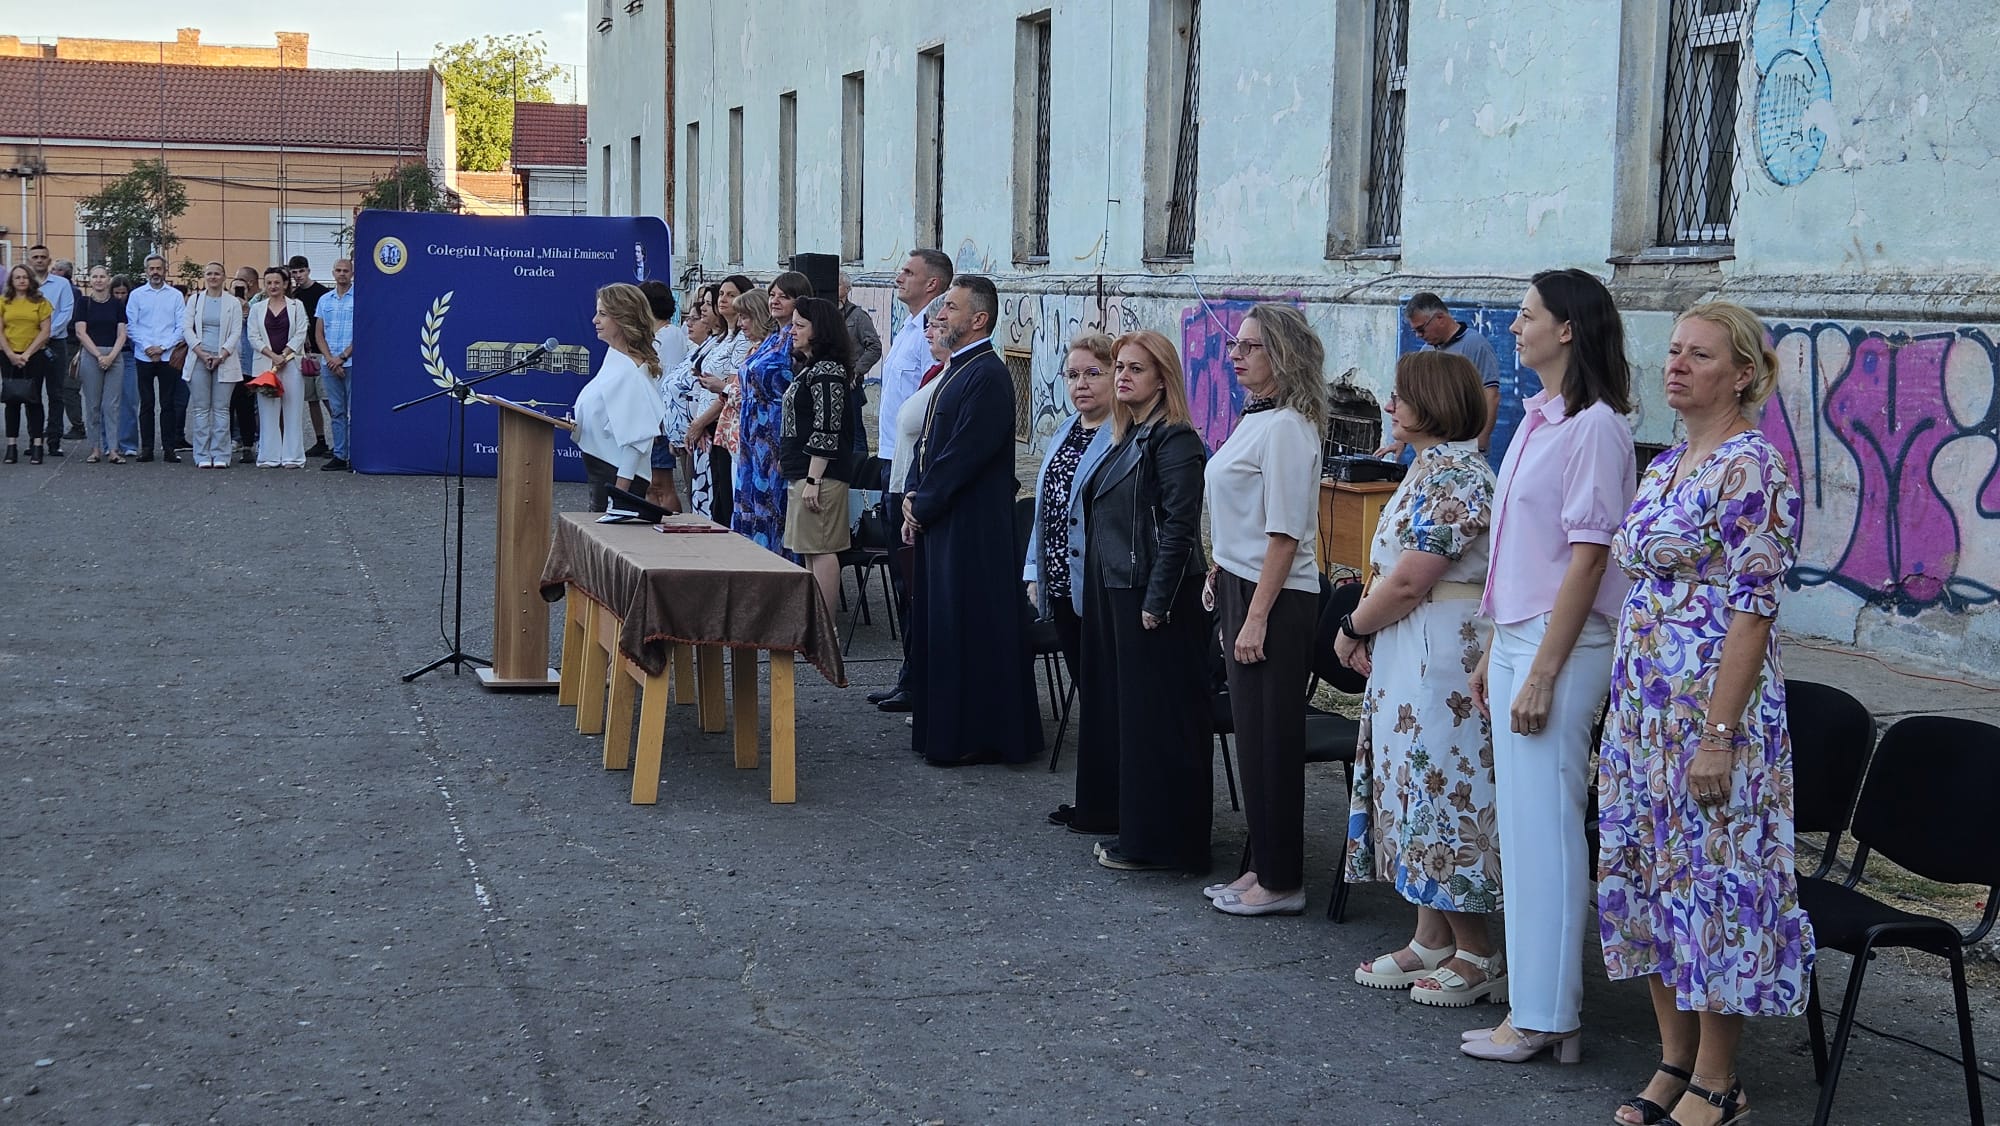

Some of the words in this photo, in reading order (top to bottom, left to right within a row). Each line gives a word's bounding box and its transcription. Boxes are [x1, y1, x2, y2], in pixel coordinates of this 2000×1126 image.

[427, 244, 481, 259] Colegiul
[483, 246, 535, 261] Național
[513, 265, 556, 278] Oradea
